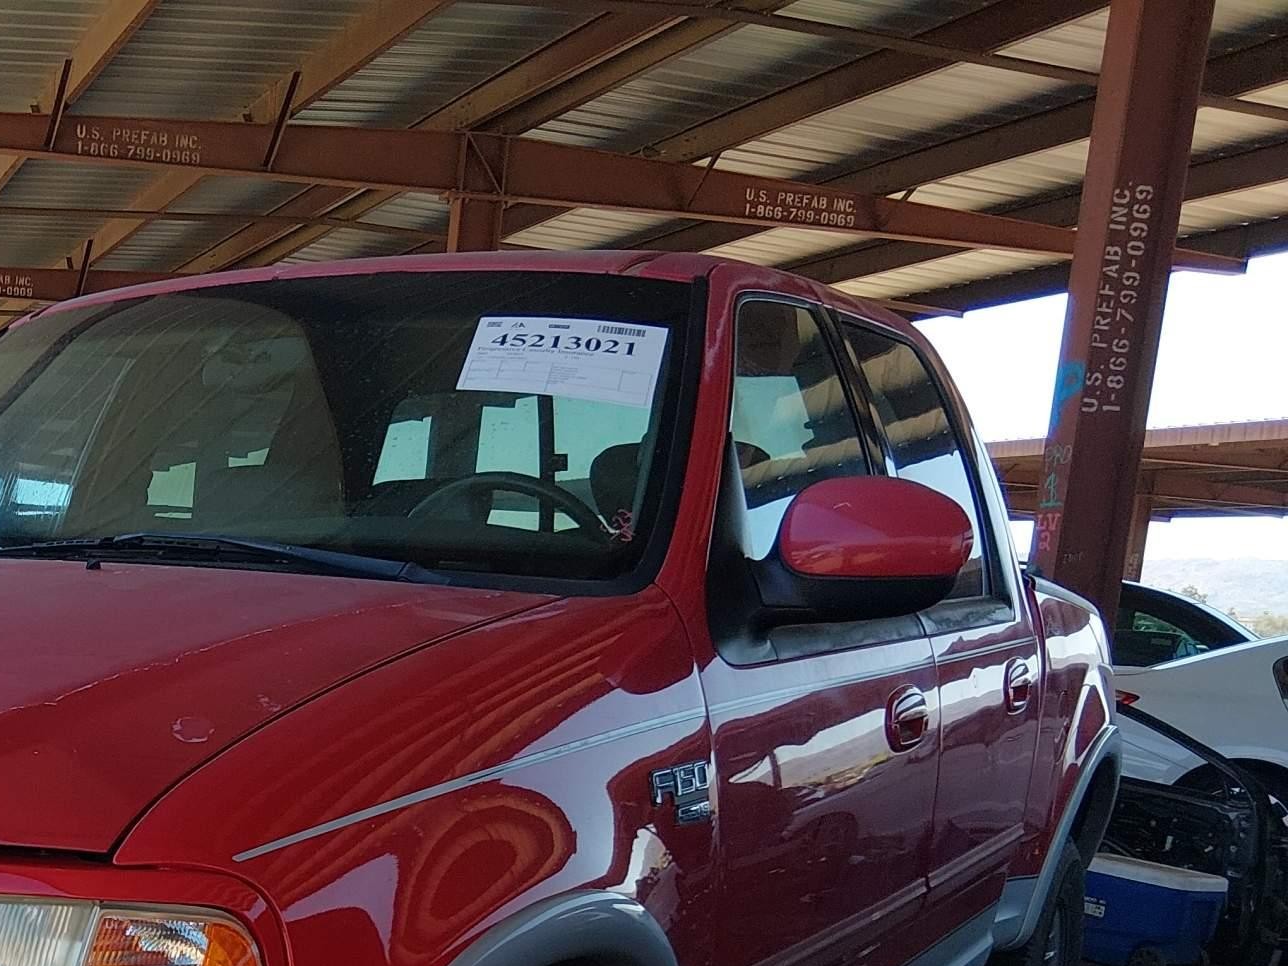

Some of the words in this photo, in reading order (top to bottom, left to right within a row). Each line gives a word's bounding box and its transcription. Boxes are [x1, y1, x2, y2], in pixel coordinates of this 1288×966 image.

[76, 124, 104, 141] U.S.
[112, 128, 168, 146] PREFAB
[175, 134, 202, 150] INC.
[745, 188, 770, 204] U.S.
[777, 192, 827, 209] PREFAB
[833, 197, 857, 213] INC.
[745, 203, 855, 227] 1-866-799-0969
[1109, 181, 1132, 230] INC.
[1091, 245, 1122, 348] PREFAB
[1102, 184, 1153, 411] 1-866-799-0969
[490, 332, 636, 357] 45213021
[1081, 364, 1104, 413] U.S.
